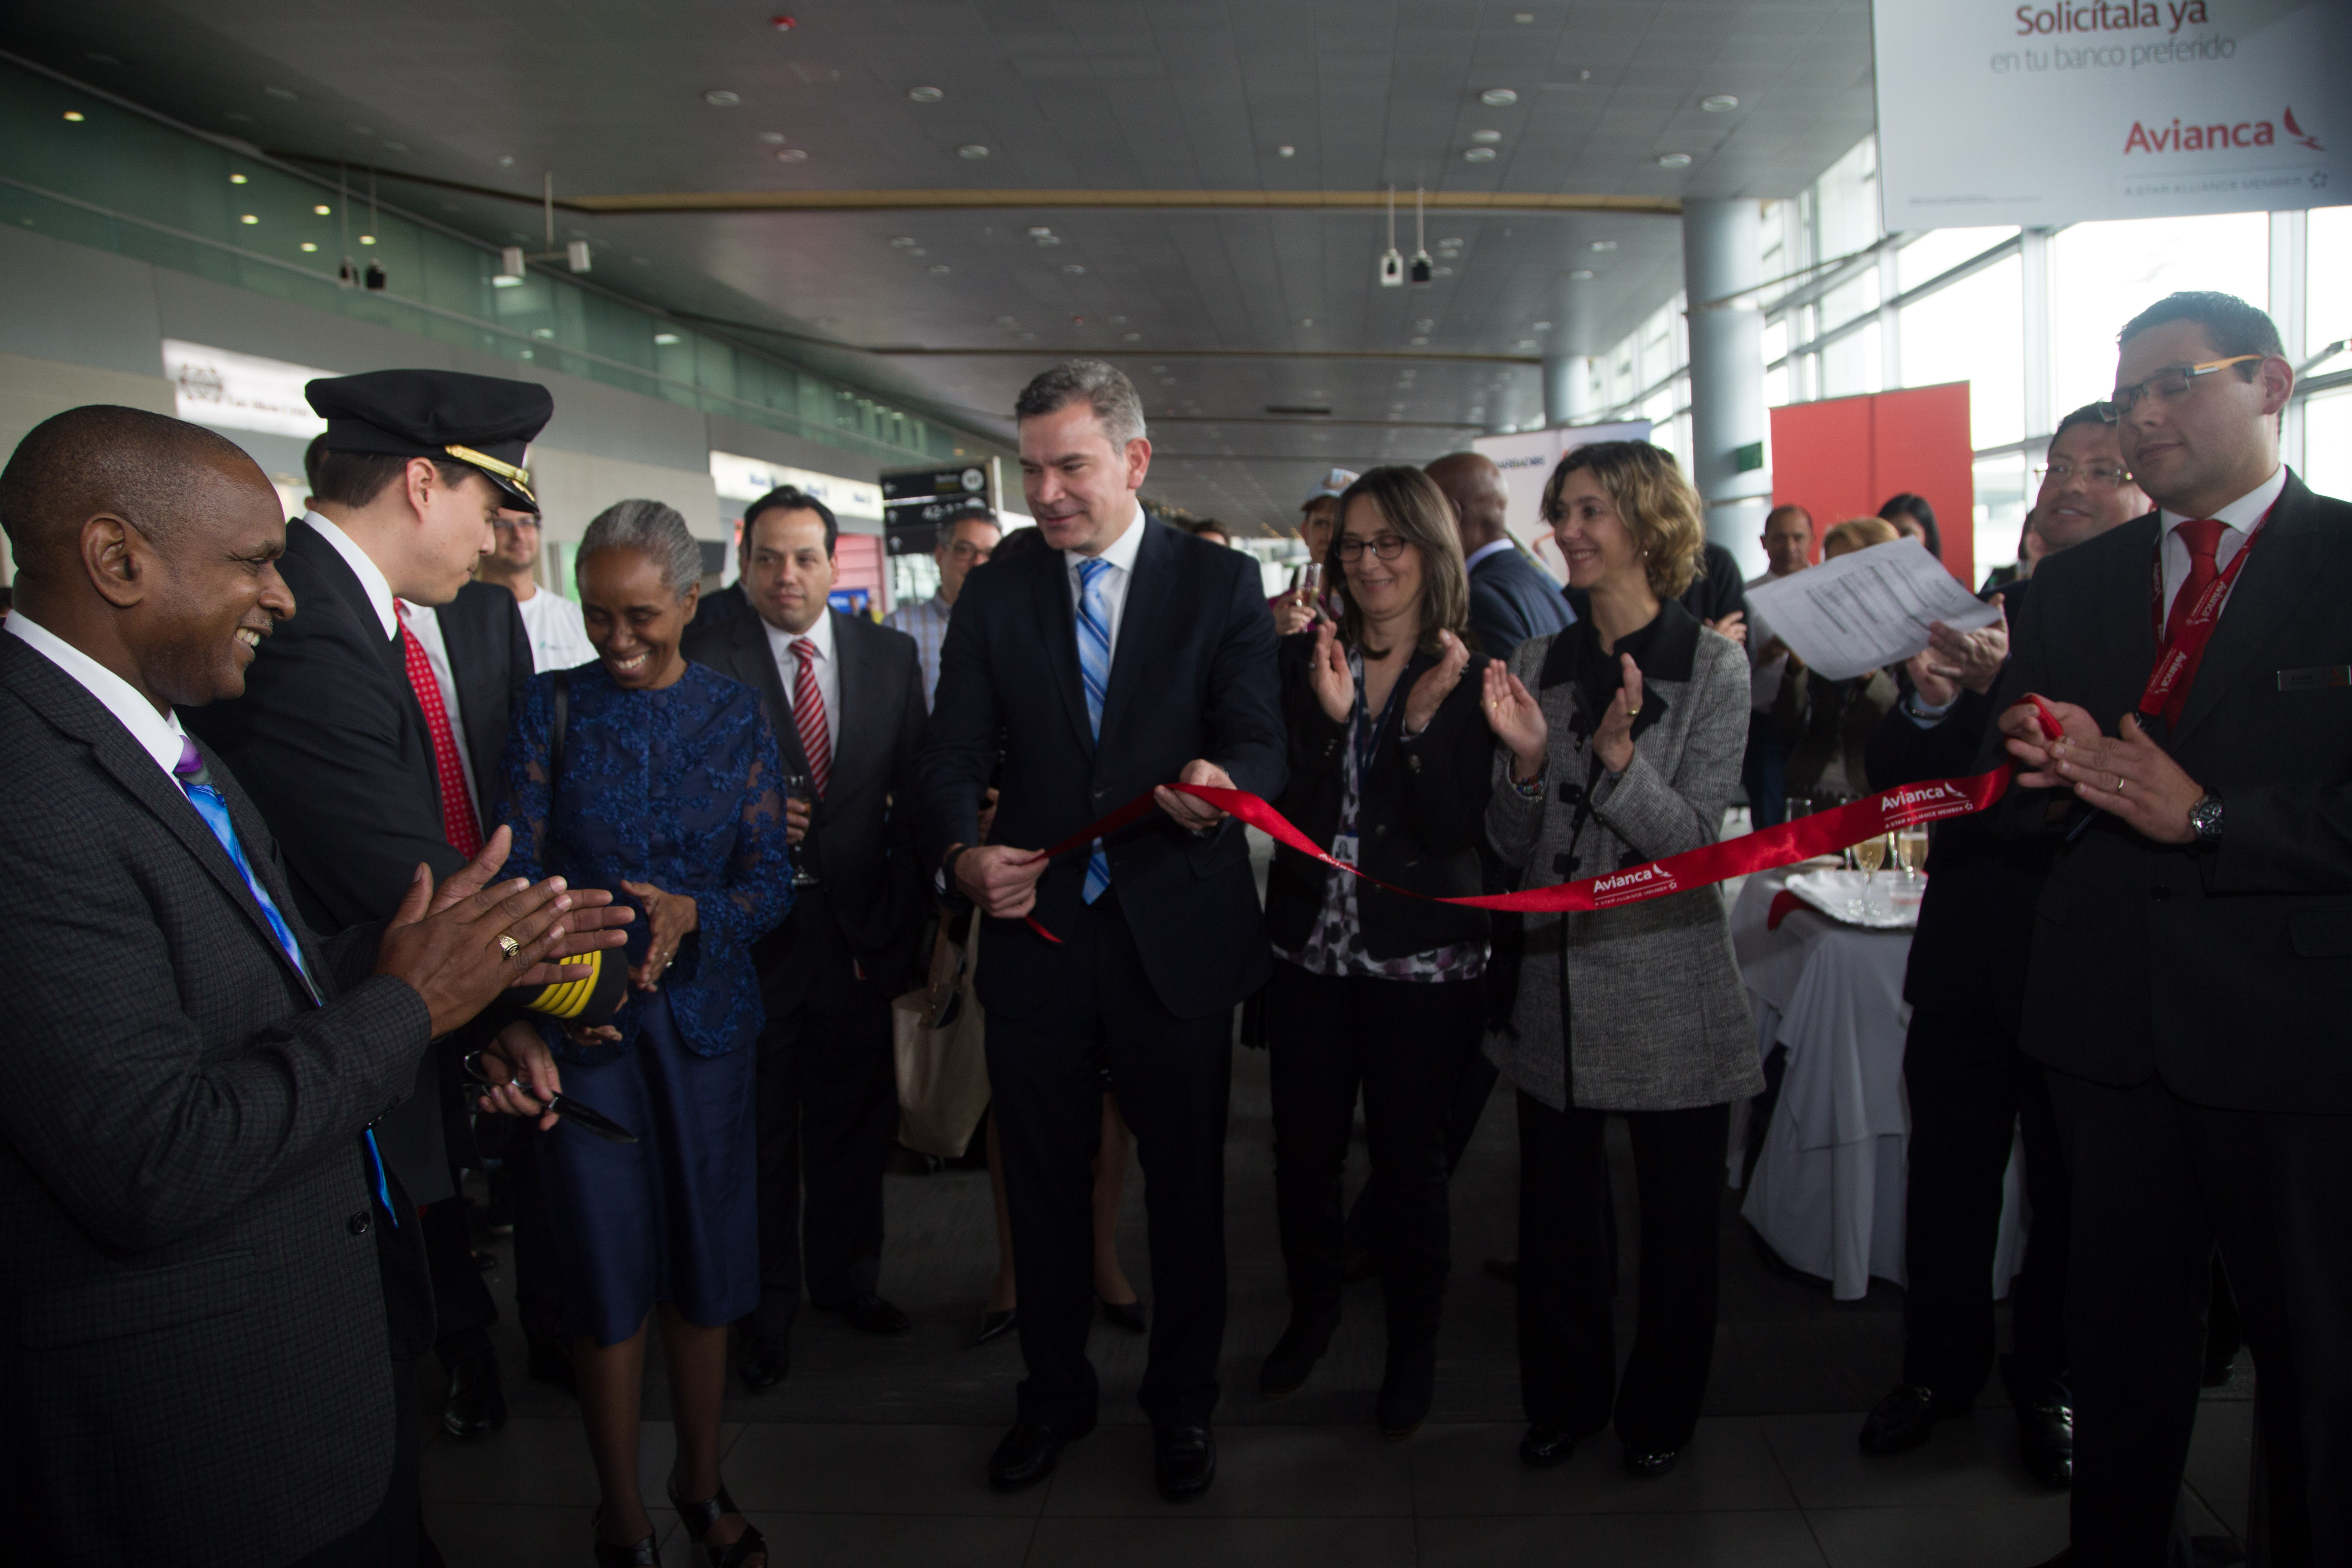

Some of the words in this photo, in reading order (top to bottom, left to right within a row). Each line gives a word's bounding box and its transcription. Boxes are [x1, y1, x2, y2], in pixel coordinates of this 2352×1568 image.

[2015, 0, 2159, 35] Solicítala
[2168, 0, 2208, 34] ya
[1990, 50, 2019, 74] en
[2024, 48, 2049, 72] tu
[2054, 46, 2125, 70] banco
[2131, 33, 2236, 70] preferido
[2124, 118, 2275, 155] Avianca
[2202, 580, 2227, 617] Avianca
[2161, 650, 2188, 688] Avianca
[1882, 787, 1945, 812] Avianca
[1892, 819, 1906, 827] STAR
[1907, 811, 1937, 823] ALLIANCE
[1938, 806, 1963, 815] MEMBER
[1594, 870, 1653, 893] Avianca
